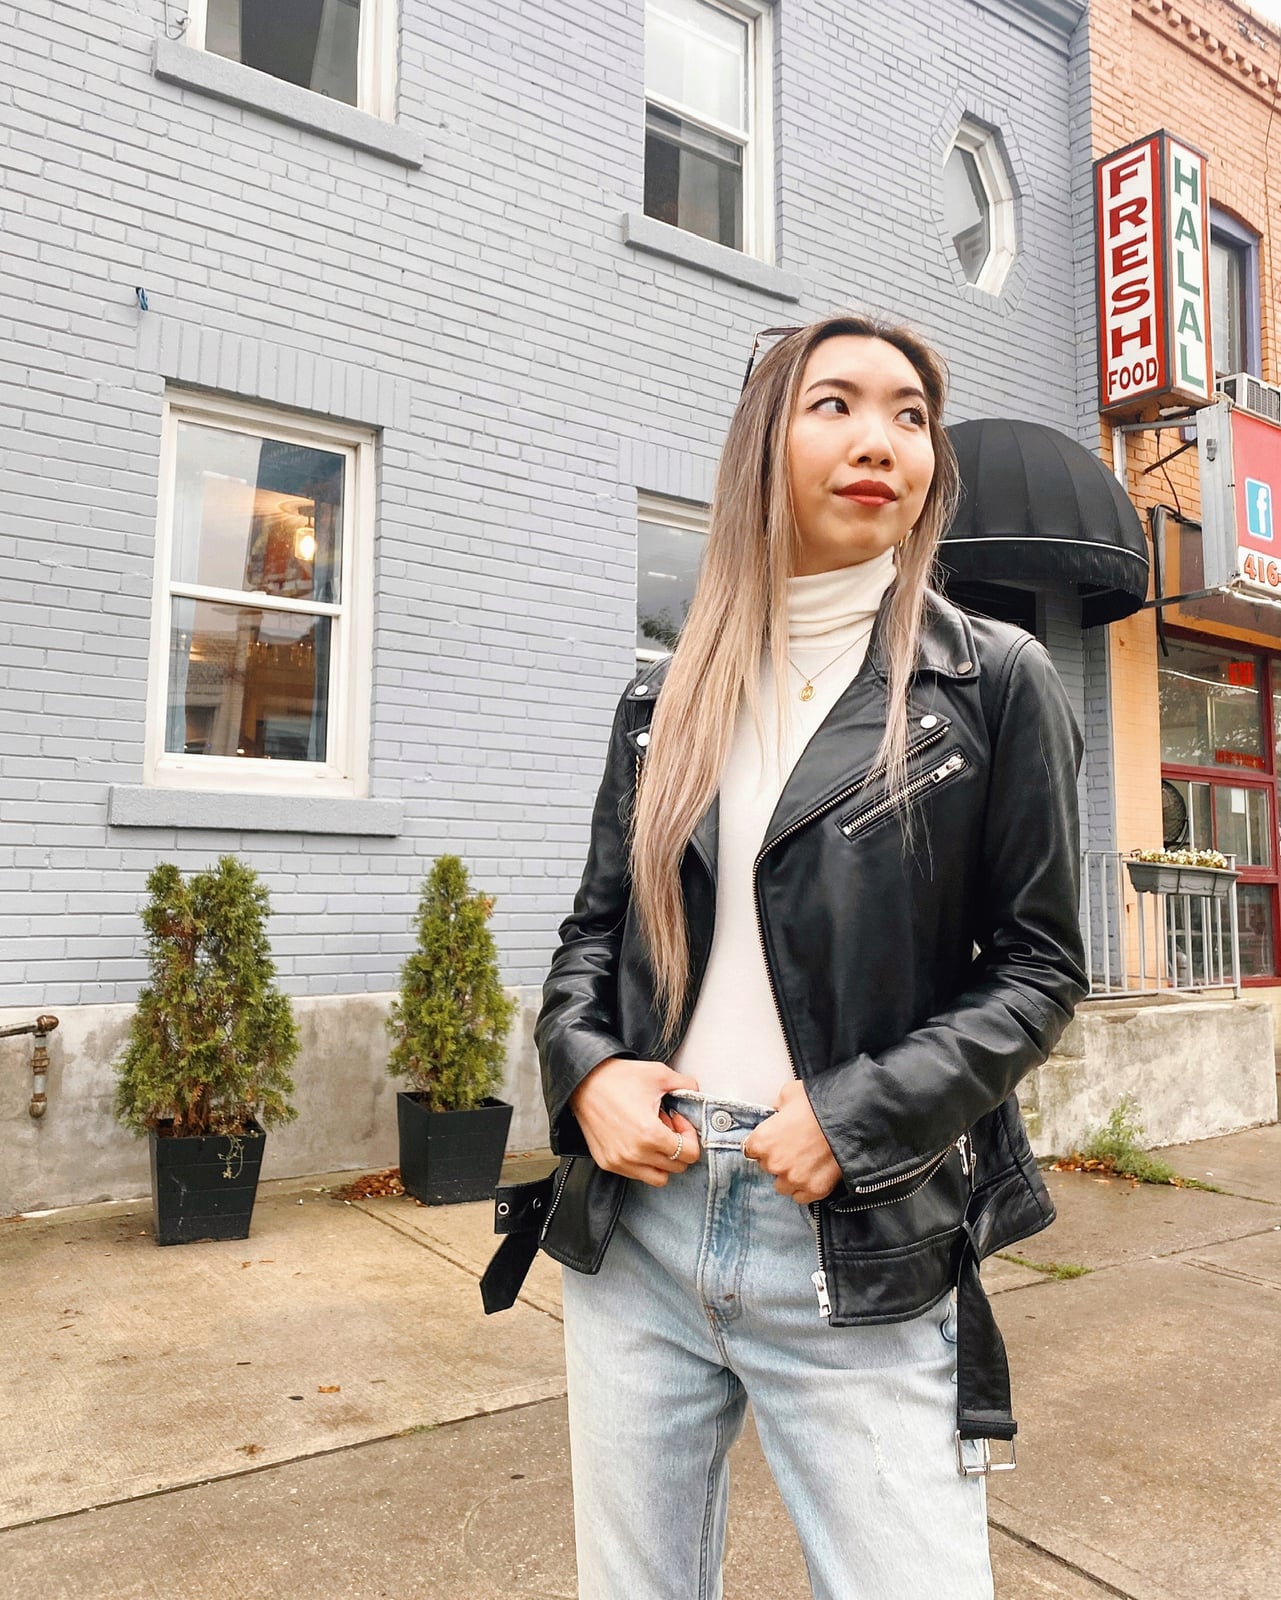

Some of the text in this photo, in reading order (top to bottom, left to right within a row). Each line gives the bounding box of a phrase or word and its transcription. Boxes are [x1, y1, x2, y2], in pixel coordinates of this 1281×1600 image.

[1109, 152, 1152, 360] FRESH
[1174, 156, 1204, 389] HALAL
[1108, 357, 1157, 395] FOOD
